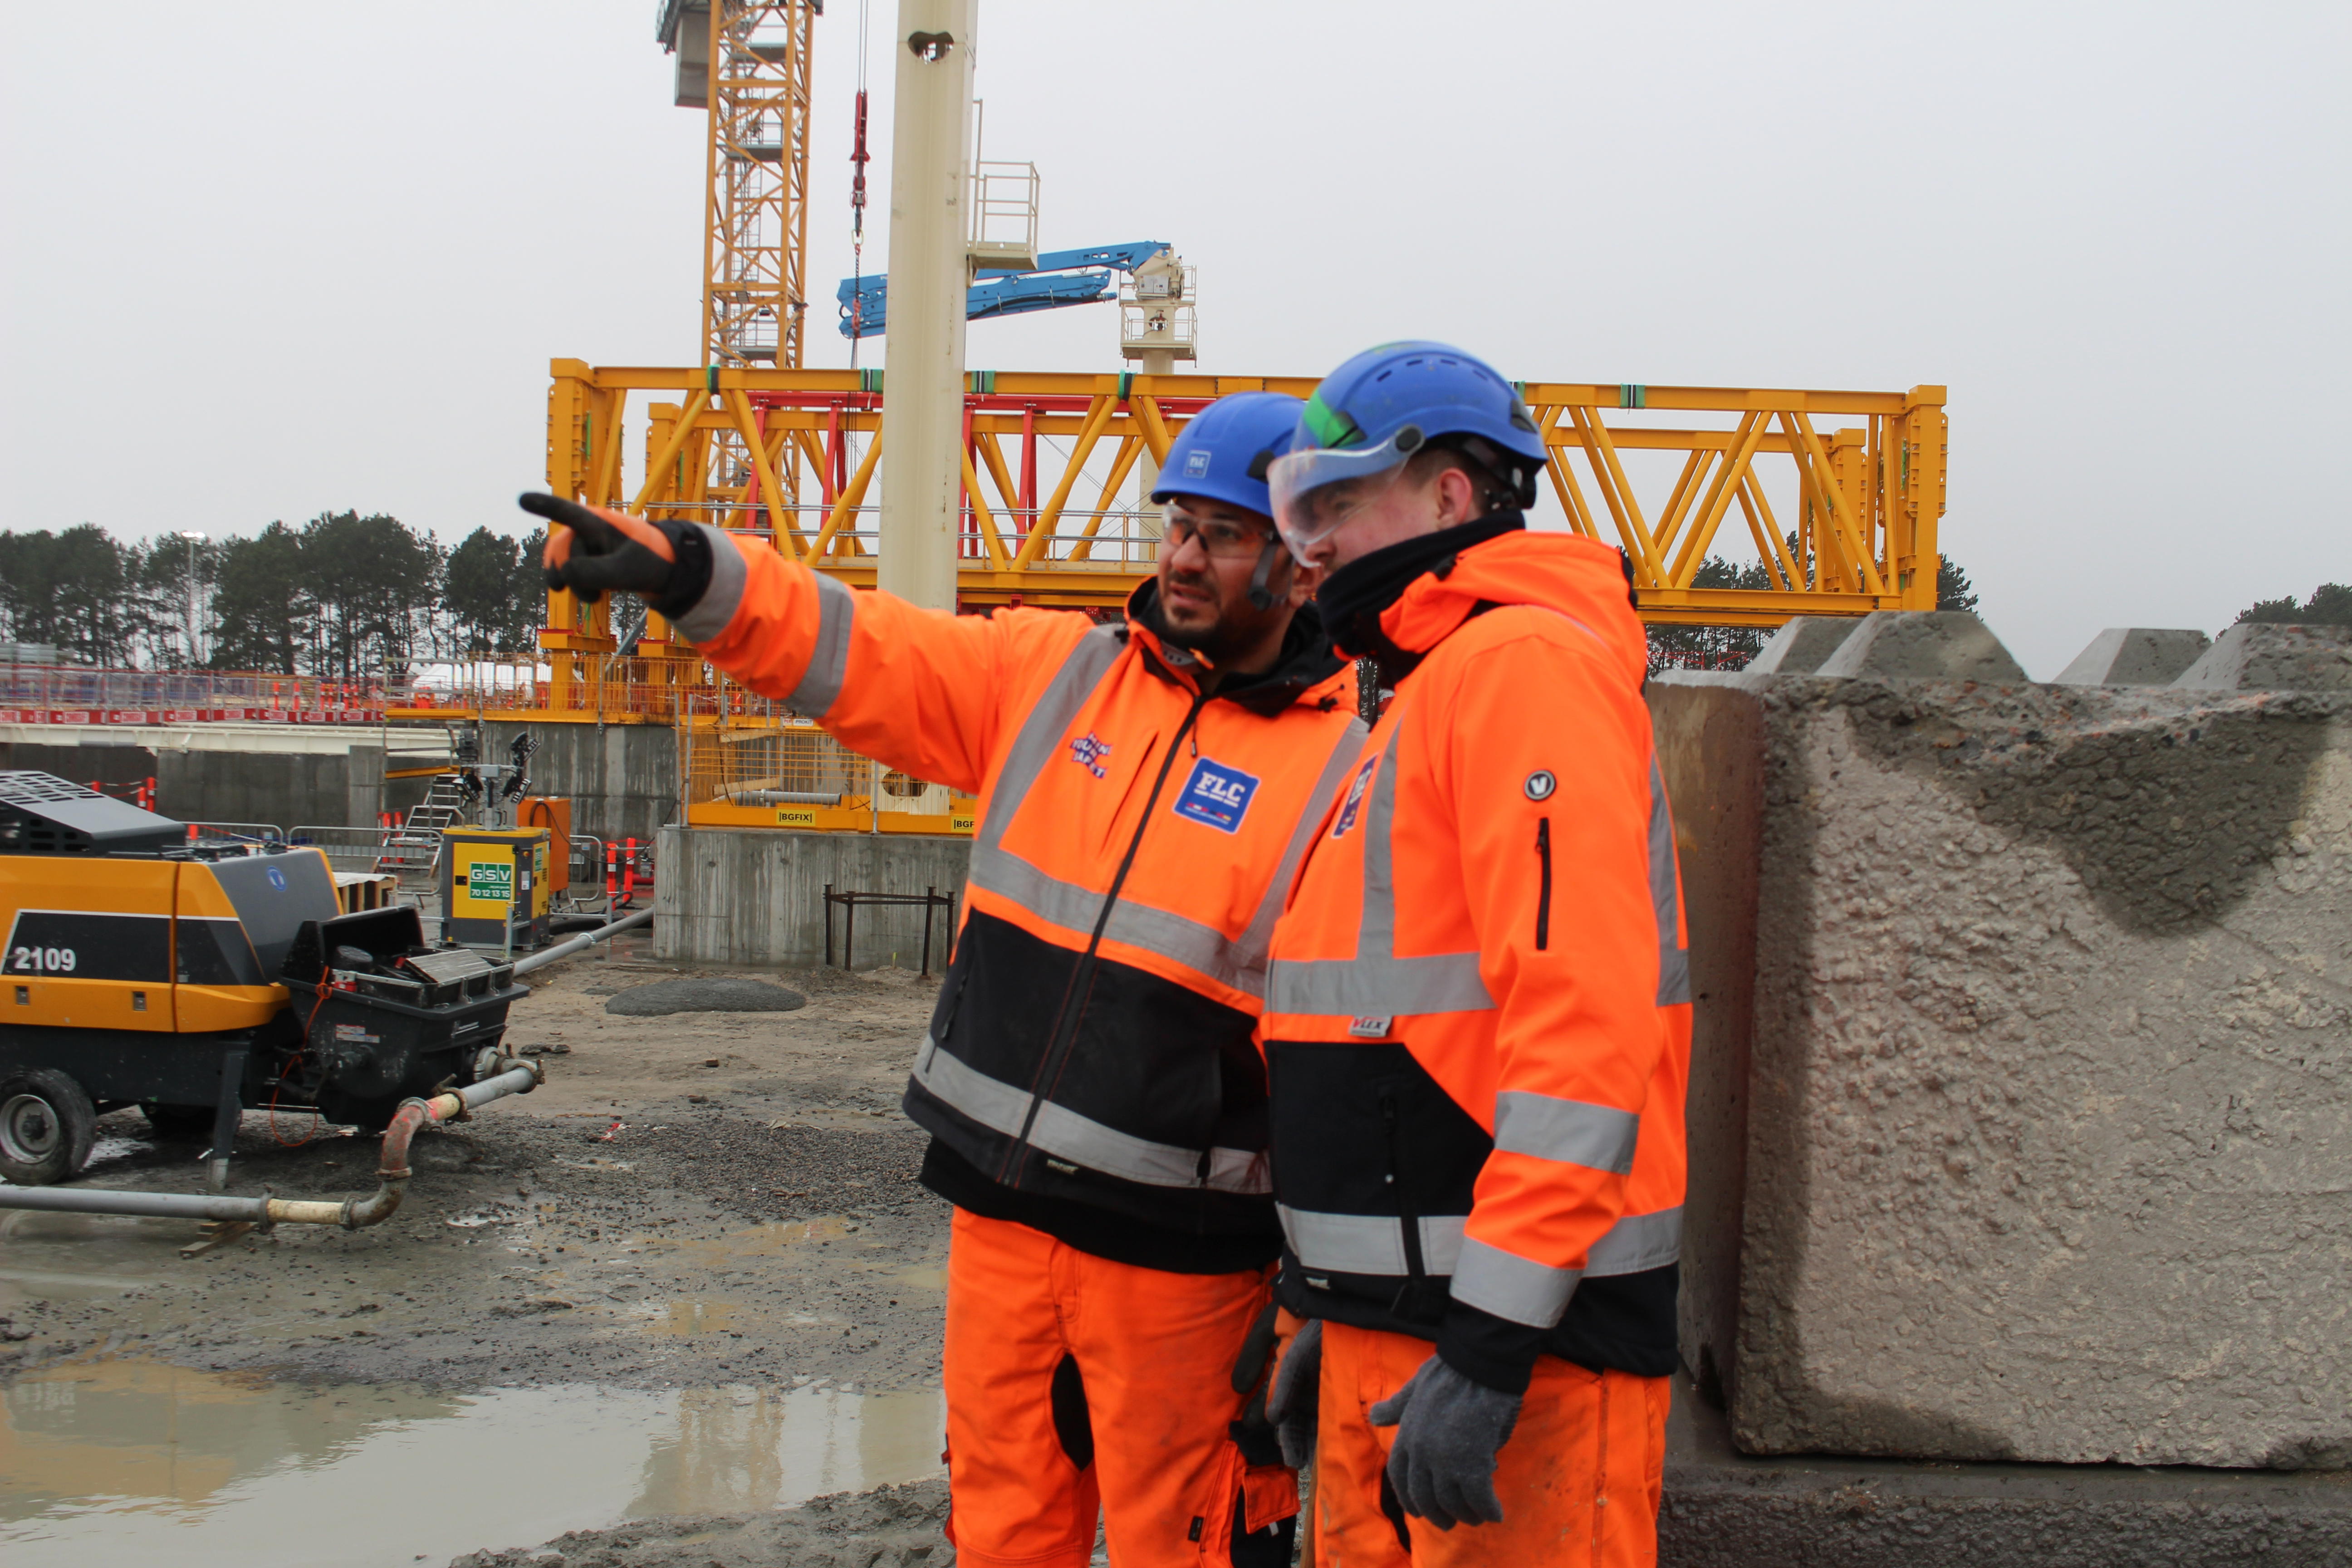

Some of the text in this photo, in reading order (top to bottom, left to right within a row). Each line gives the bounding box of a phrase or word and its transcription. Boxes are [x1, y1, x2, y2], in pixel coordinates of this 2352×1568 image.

[1196, 771, 1245, 803] FLC
[471, 869, 510, 881] GSV
[14, 946, 76, 971] 2109
